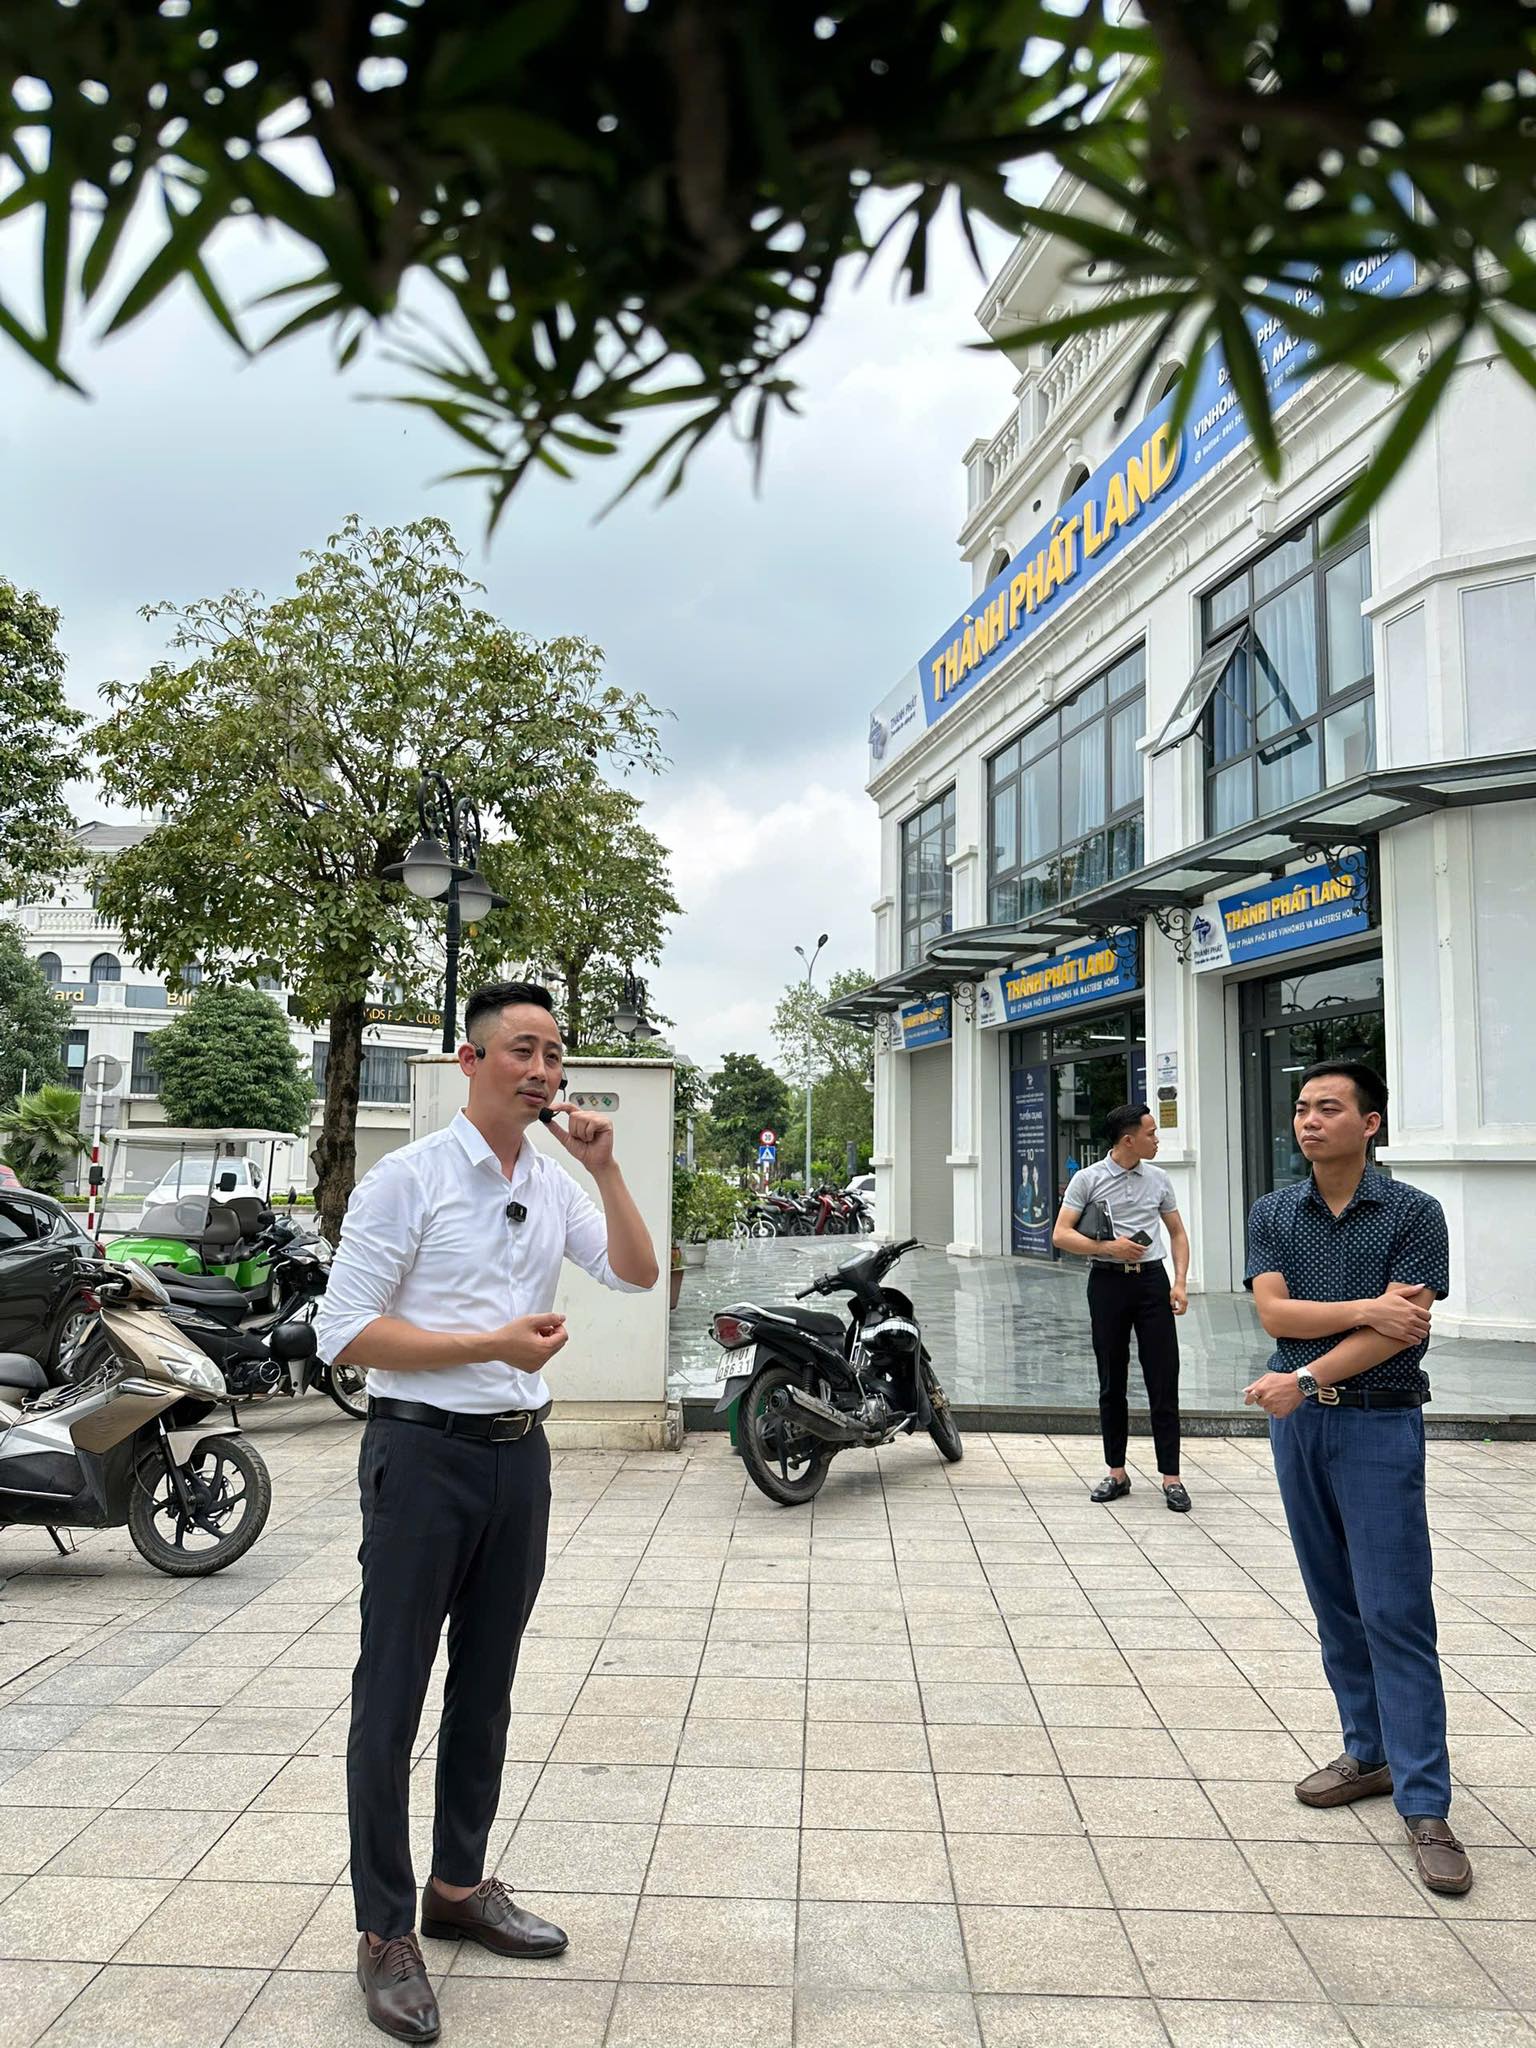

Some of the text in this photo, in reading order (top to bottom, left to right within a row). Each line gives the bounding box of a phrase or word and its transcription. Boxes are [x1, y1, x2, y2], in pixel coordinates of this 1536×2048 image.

[1194, 388, 1240, 441] VINHOM
[931, 421, 1183, 702] THÀNH PHÁT LAND
[1225, 874, 1355, 933] THÀNH PHÁT LAND
[1006, 948, 1118, 1001] THÀNH PHÁT LAND
